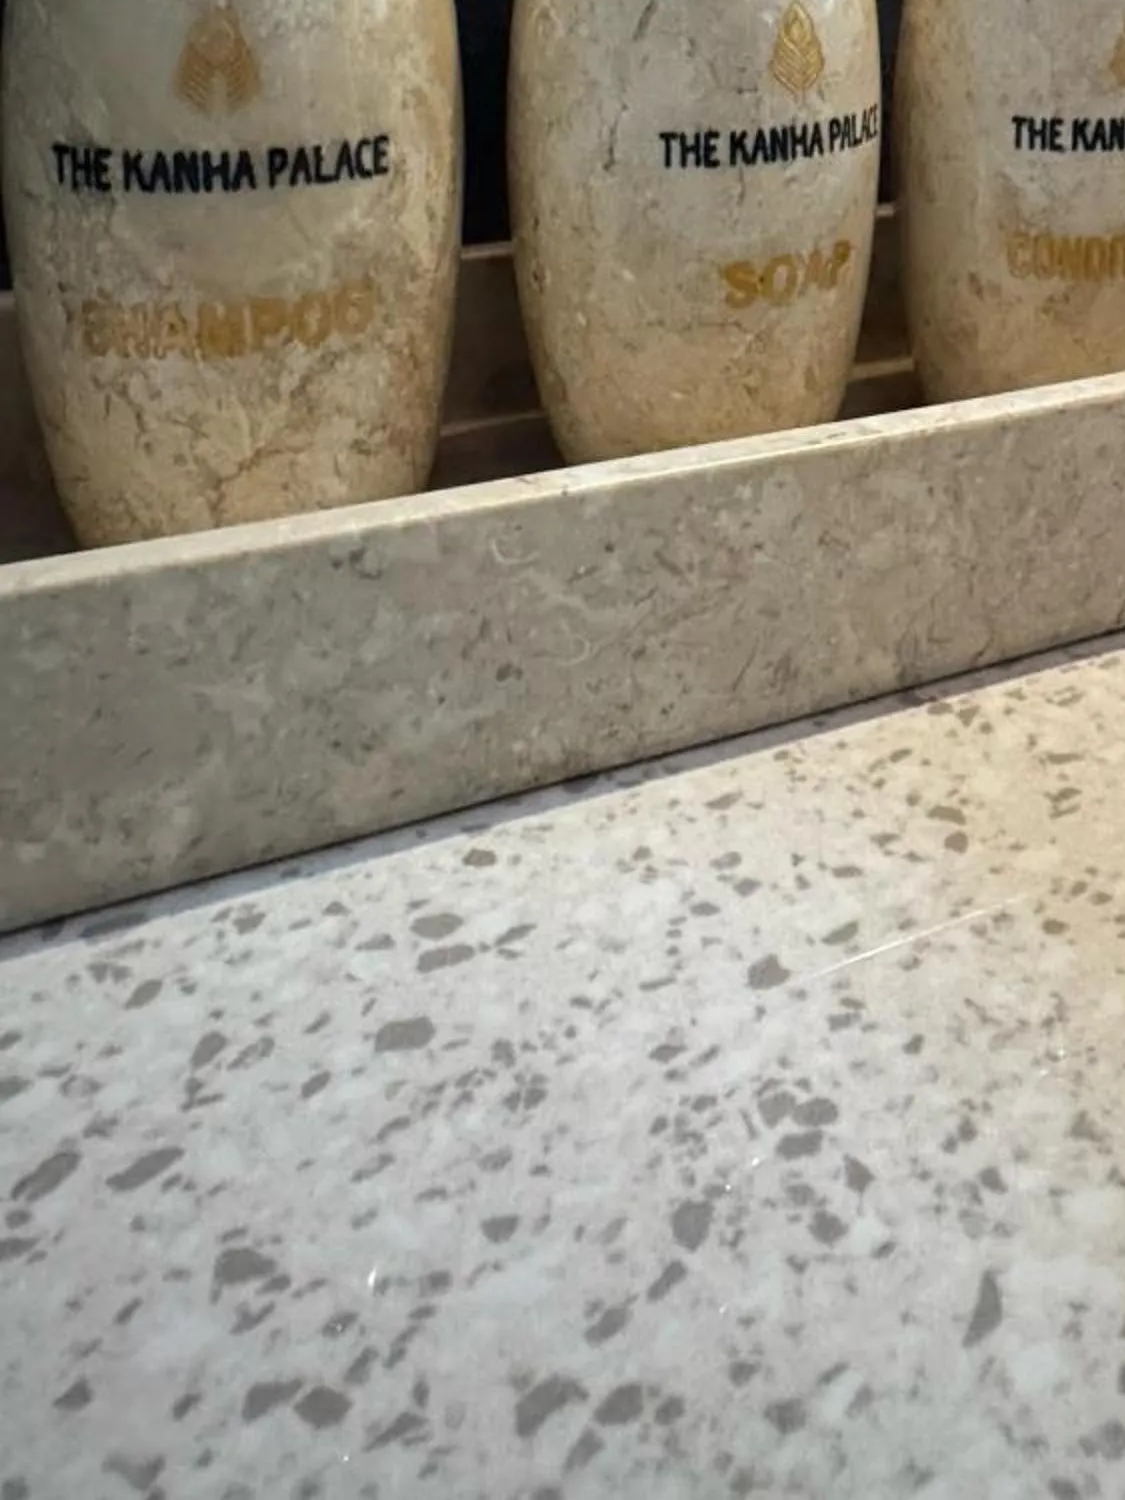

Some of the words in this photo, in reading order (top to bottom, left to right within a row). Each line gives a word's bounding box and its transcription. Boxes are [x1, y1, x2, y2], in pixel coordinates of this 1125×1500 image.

[659, 131, 720, 169] THE
[729, 121, 823, 167] KANHA
[1012, 115, 1064, 152] THE
[52, 143, 112, 192] THE
[123, 149, 257, 193] KANHA
[267, 134, 391, 188] PALACE
